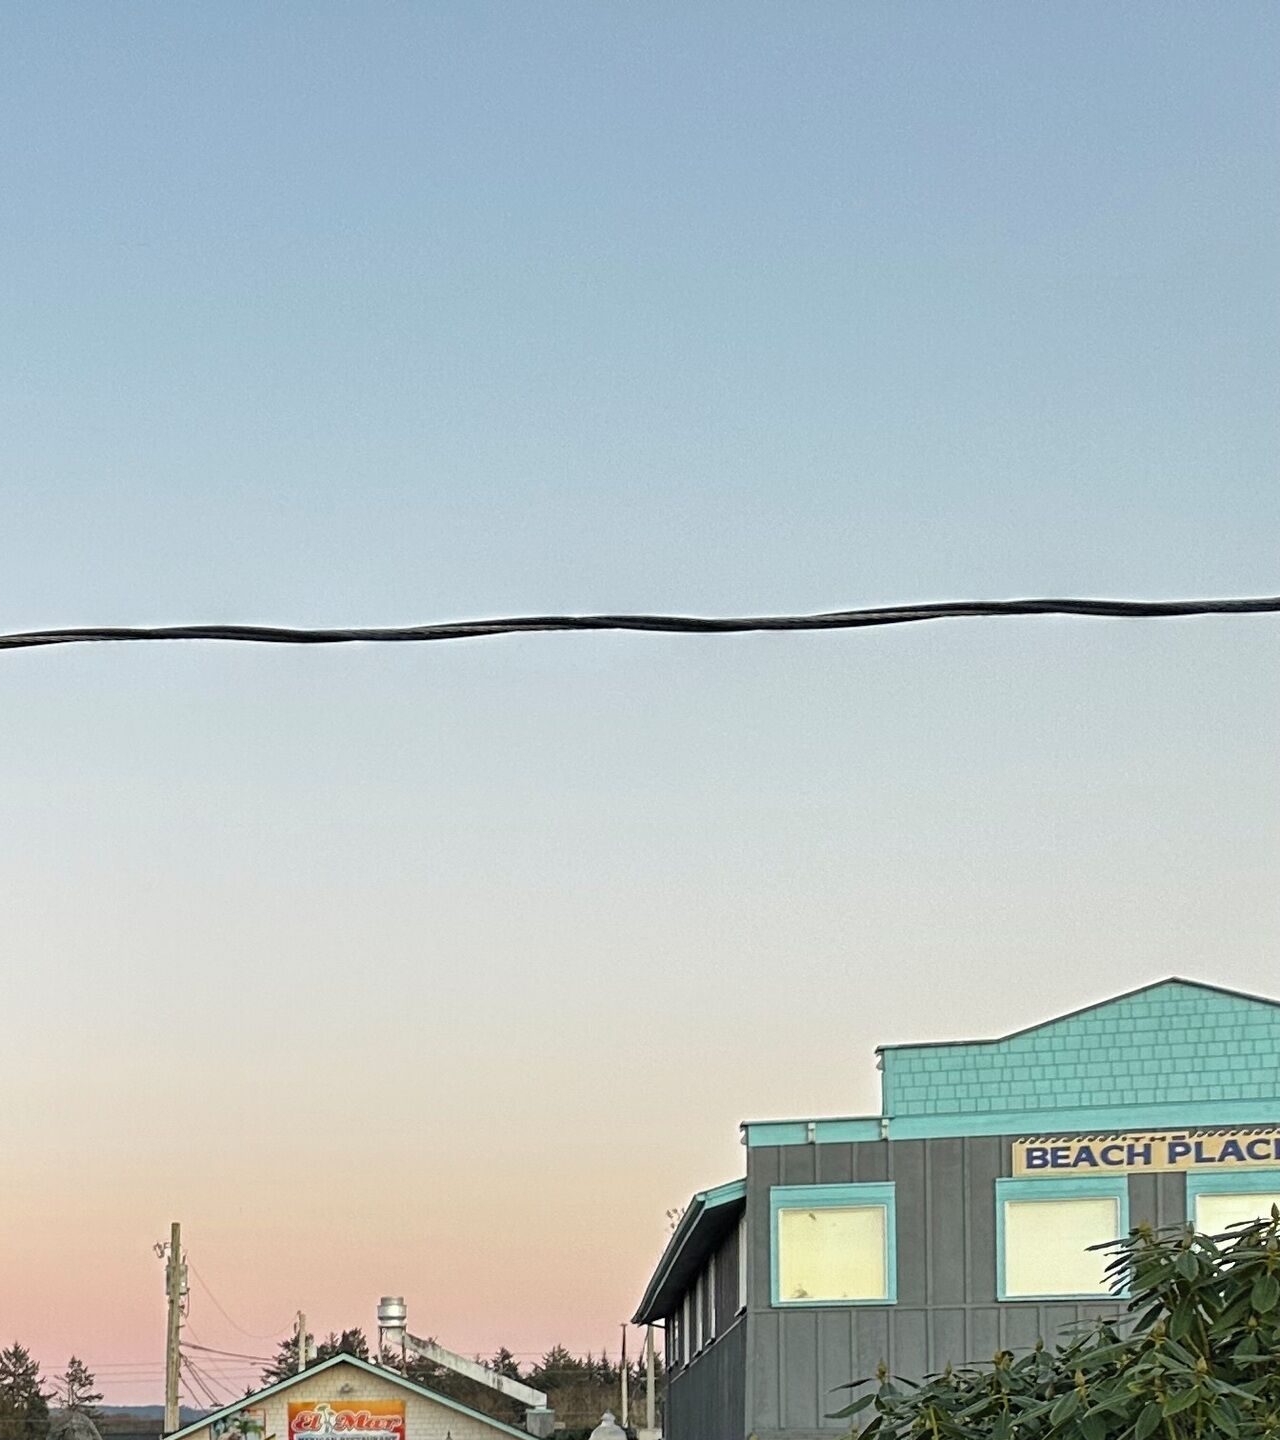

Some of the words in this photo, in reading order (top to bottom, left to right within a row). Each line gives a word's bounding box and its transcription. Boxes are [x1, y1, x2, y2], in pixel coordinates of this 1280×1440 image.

[1025, 1143, 1152, 1169] BEACH
[291, 1411, 323, 1432] El
[334, 1410, 402, 1433] Mar
